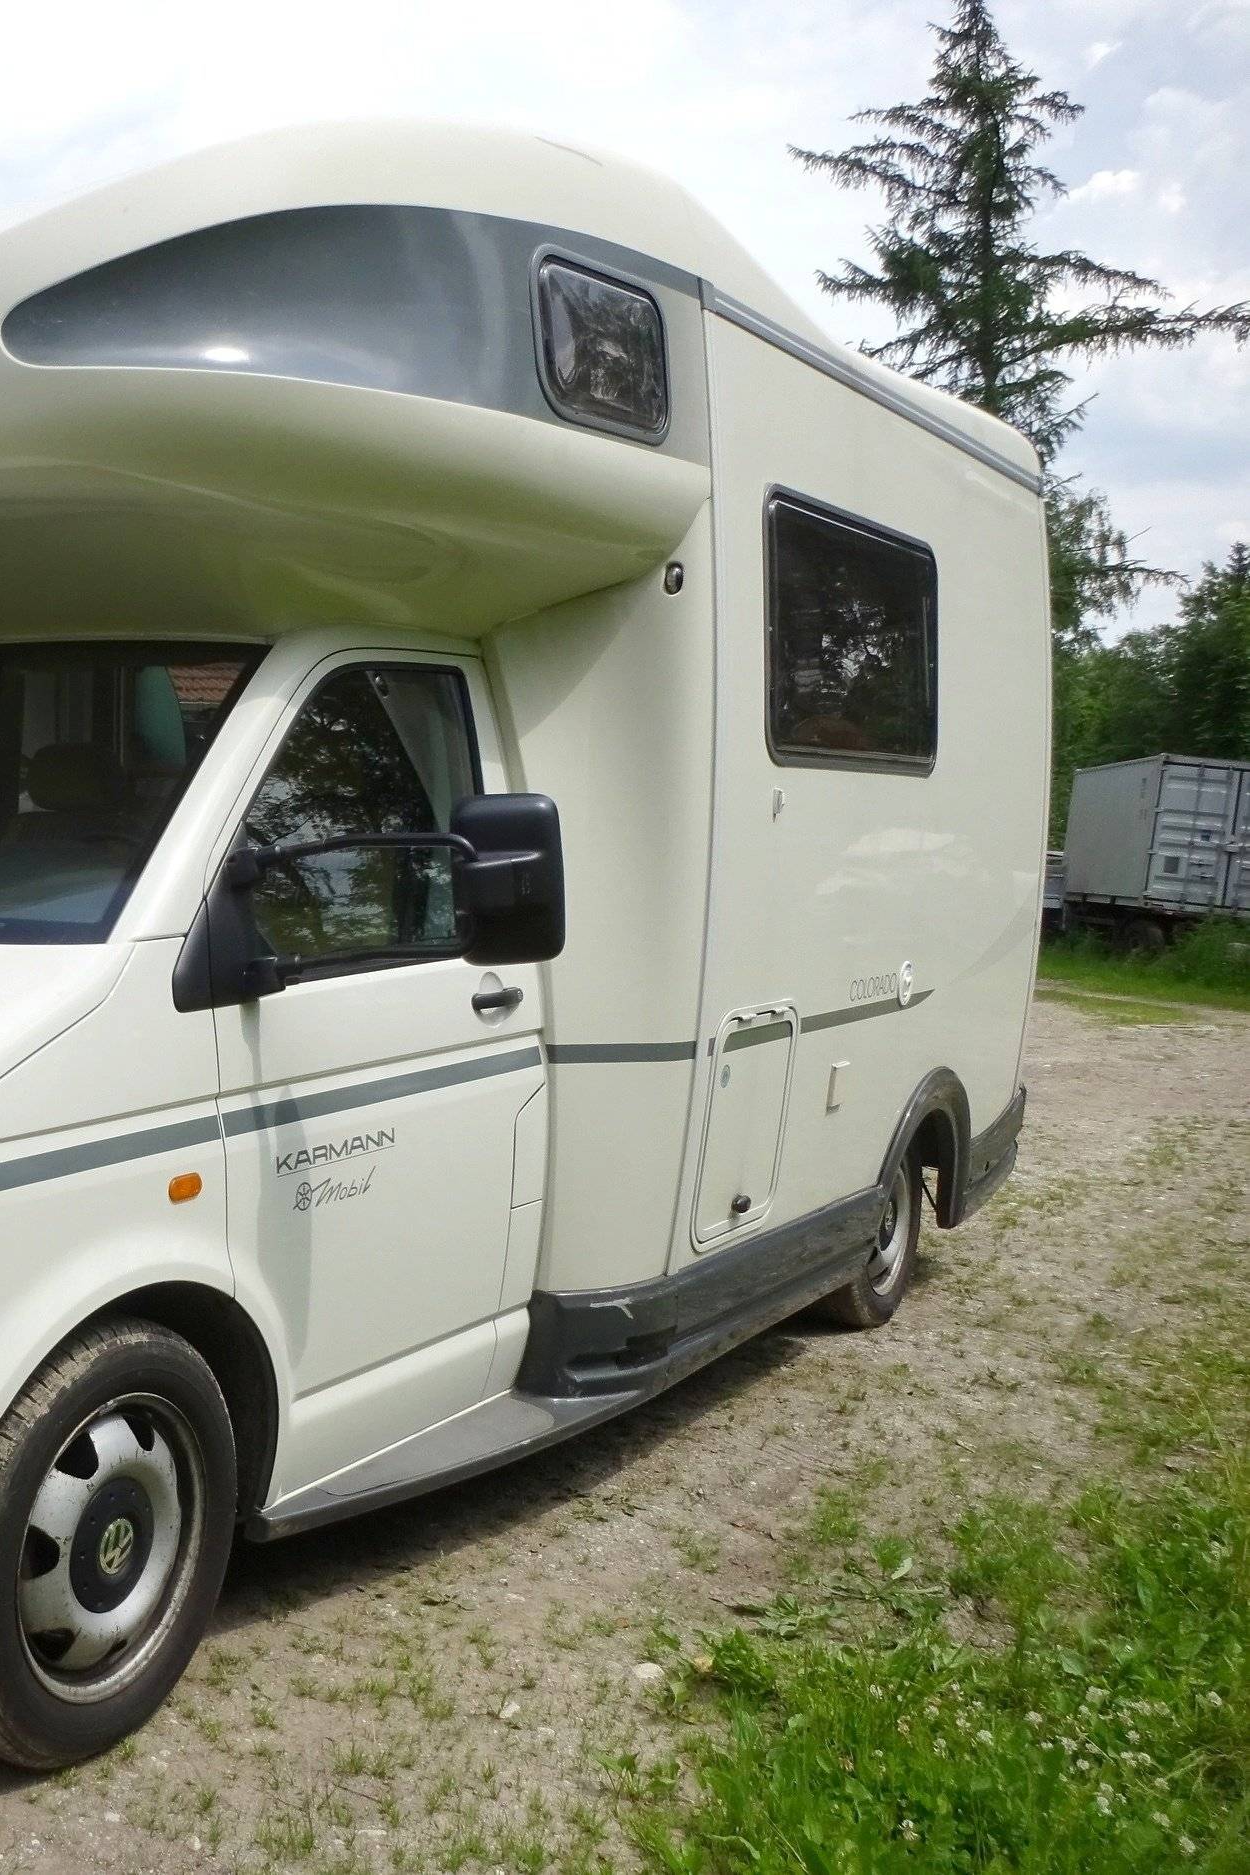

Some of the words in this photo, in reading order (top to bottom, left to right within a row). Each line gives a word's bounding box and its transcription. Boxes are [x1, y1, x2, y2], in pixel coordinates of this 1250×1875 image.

[849, 973, 897, 1002] COLORADO
[276, 1128, 395, 1173] KARMANN
[313, 1166, 377, 1207] Mobil
